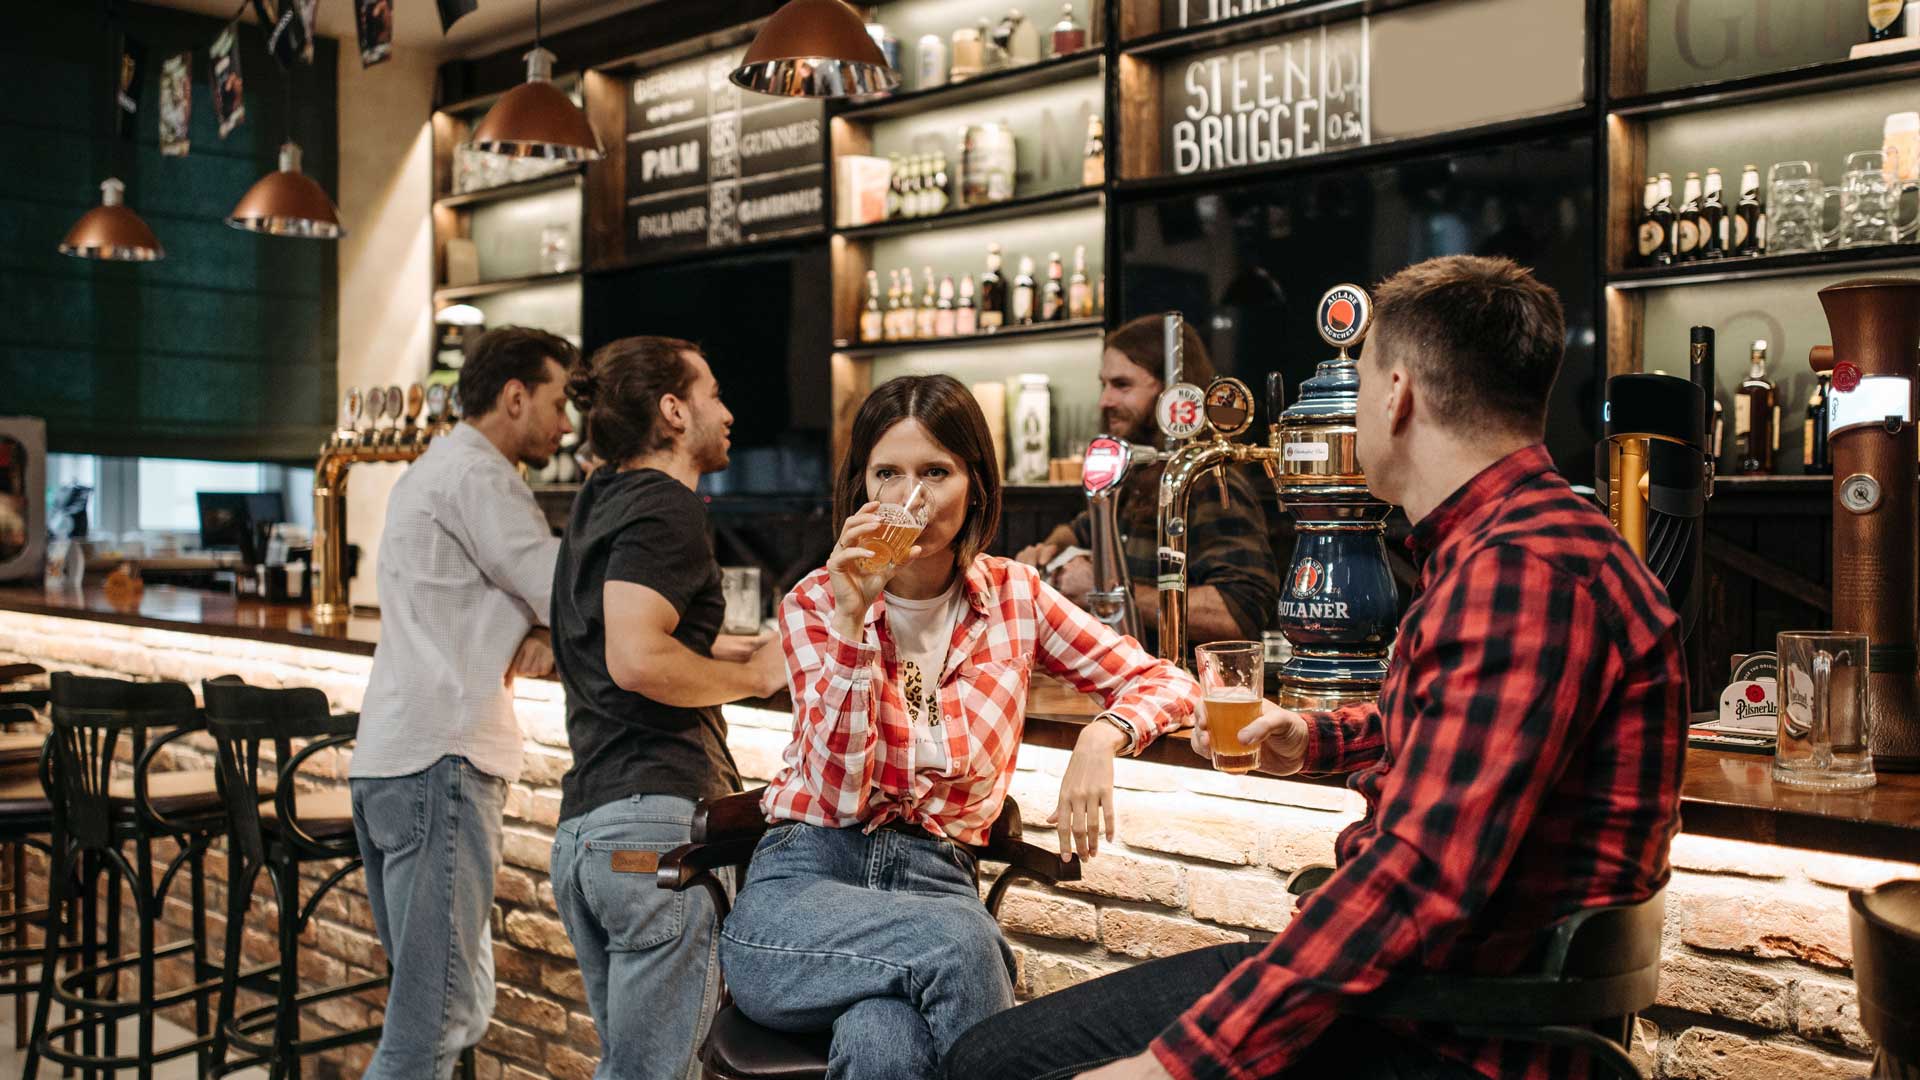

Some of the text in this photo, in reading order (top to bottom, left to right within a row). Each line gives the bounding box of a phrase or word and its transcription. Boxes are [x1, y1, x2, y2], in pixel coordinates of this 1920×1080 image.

[1185, 38, 1312, 120] STEEN
[1173, 99, 1319, 174] BRUGGE
[641, 139, 700, 183] PALM
[1168, 400, 1198, 425] 13
[1735, 698, 1767, 721] Pilsner
